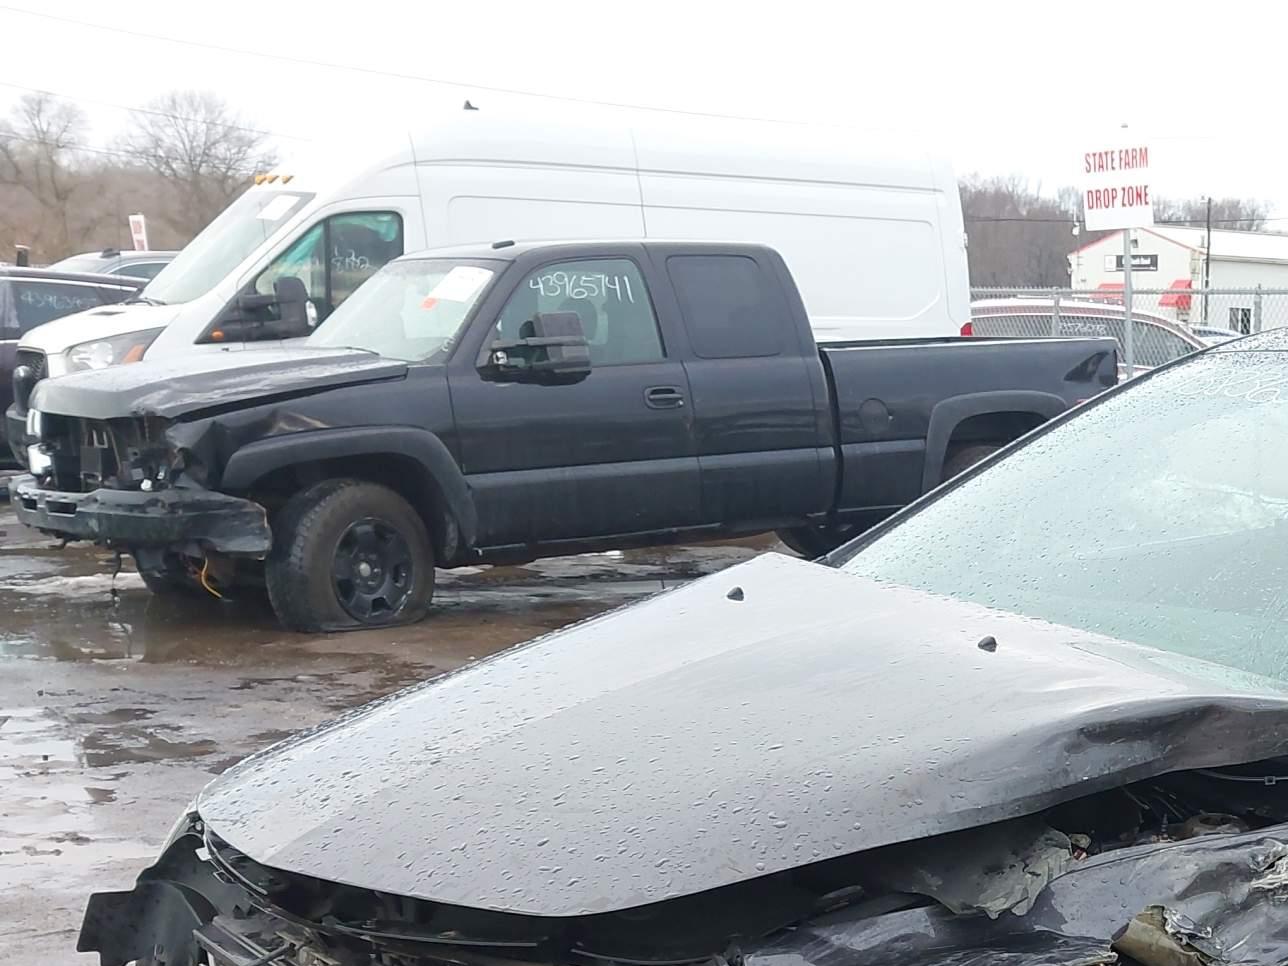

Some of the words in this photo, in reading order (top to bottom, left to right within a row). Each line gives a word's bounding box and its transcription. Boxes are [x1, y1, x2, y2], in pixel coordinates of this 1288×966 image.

[1084, 149, 1116, 174] STATE
[1119, 146, 1149, 170] FARM
[1087, 187, 1118, 210] DROP
[1121, 184, 1149, 208] ZONE
[529, 271, 634, 304] 43965741
